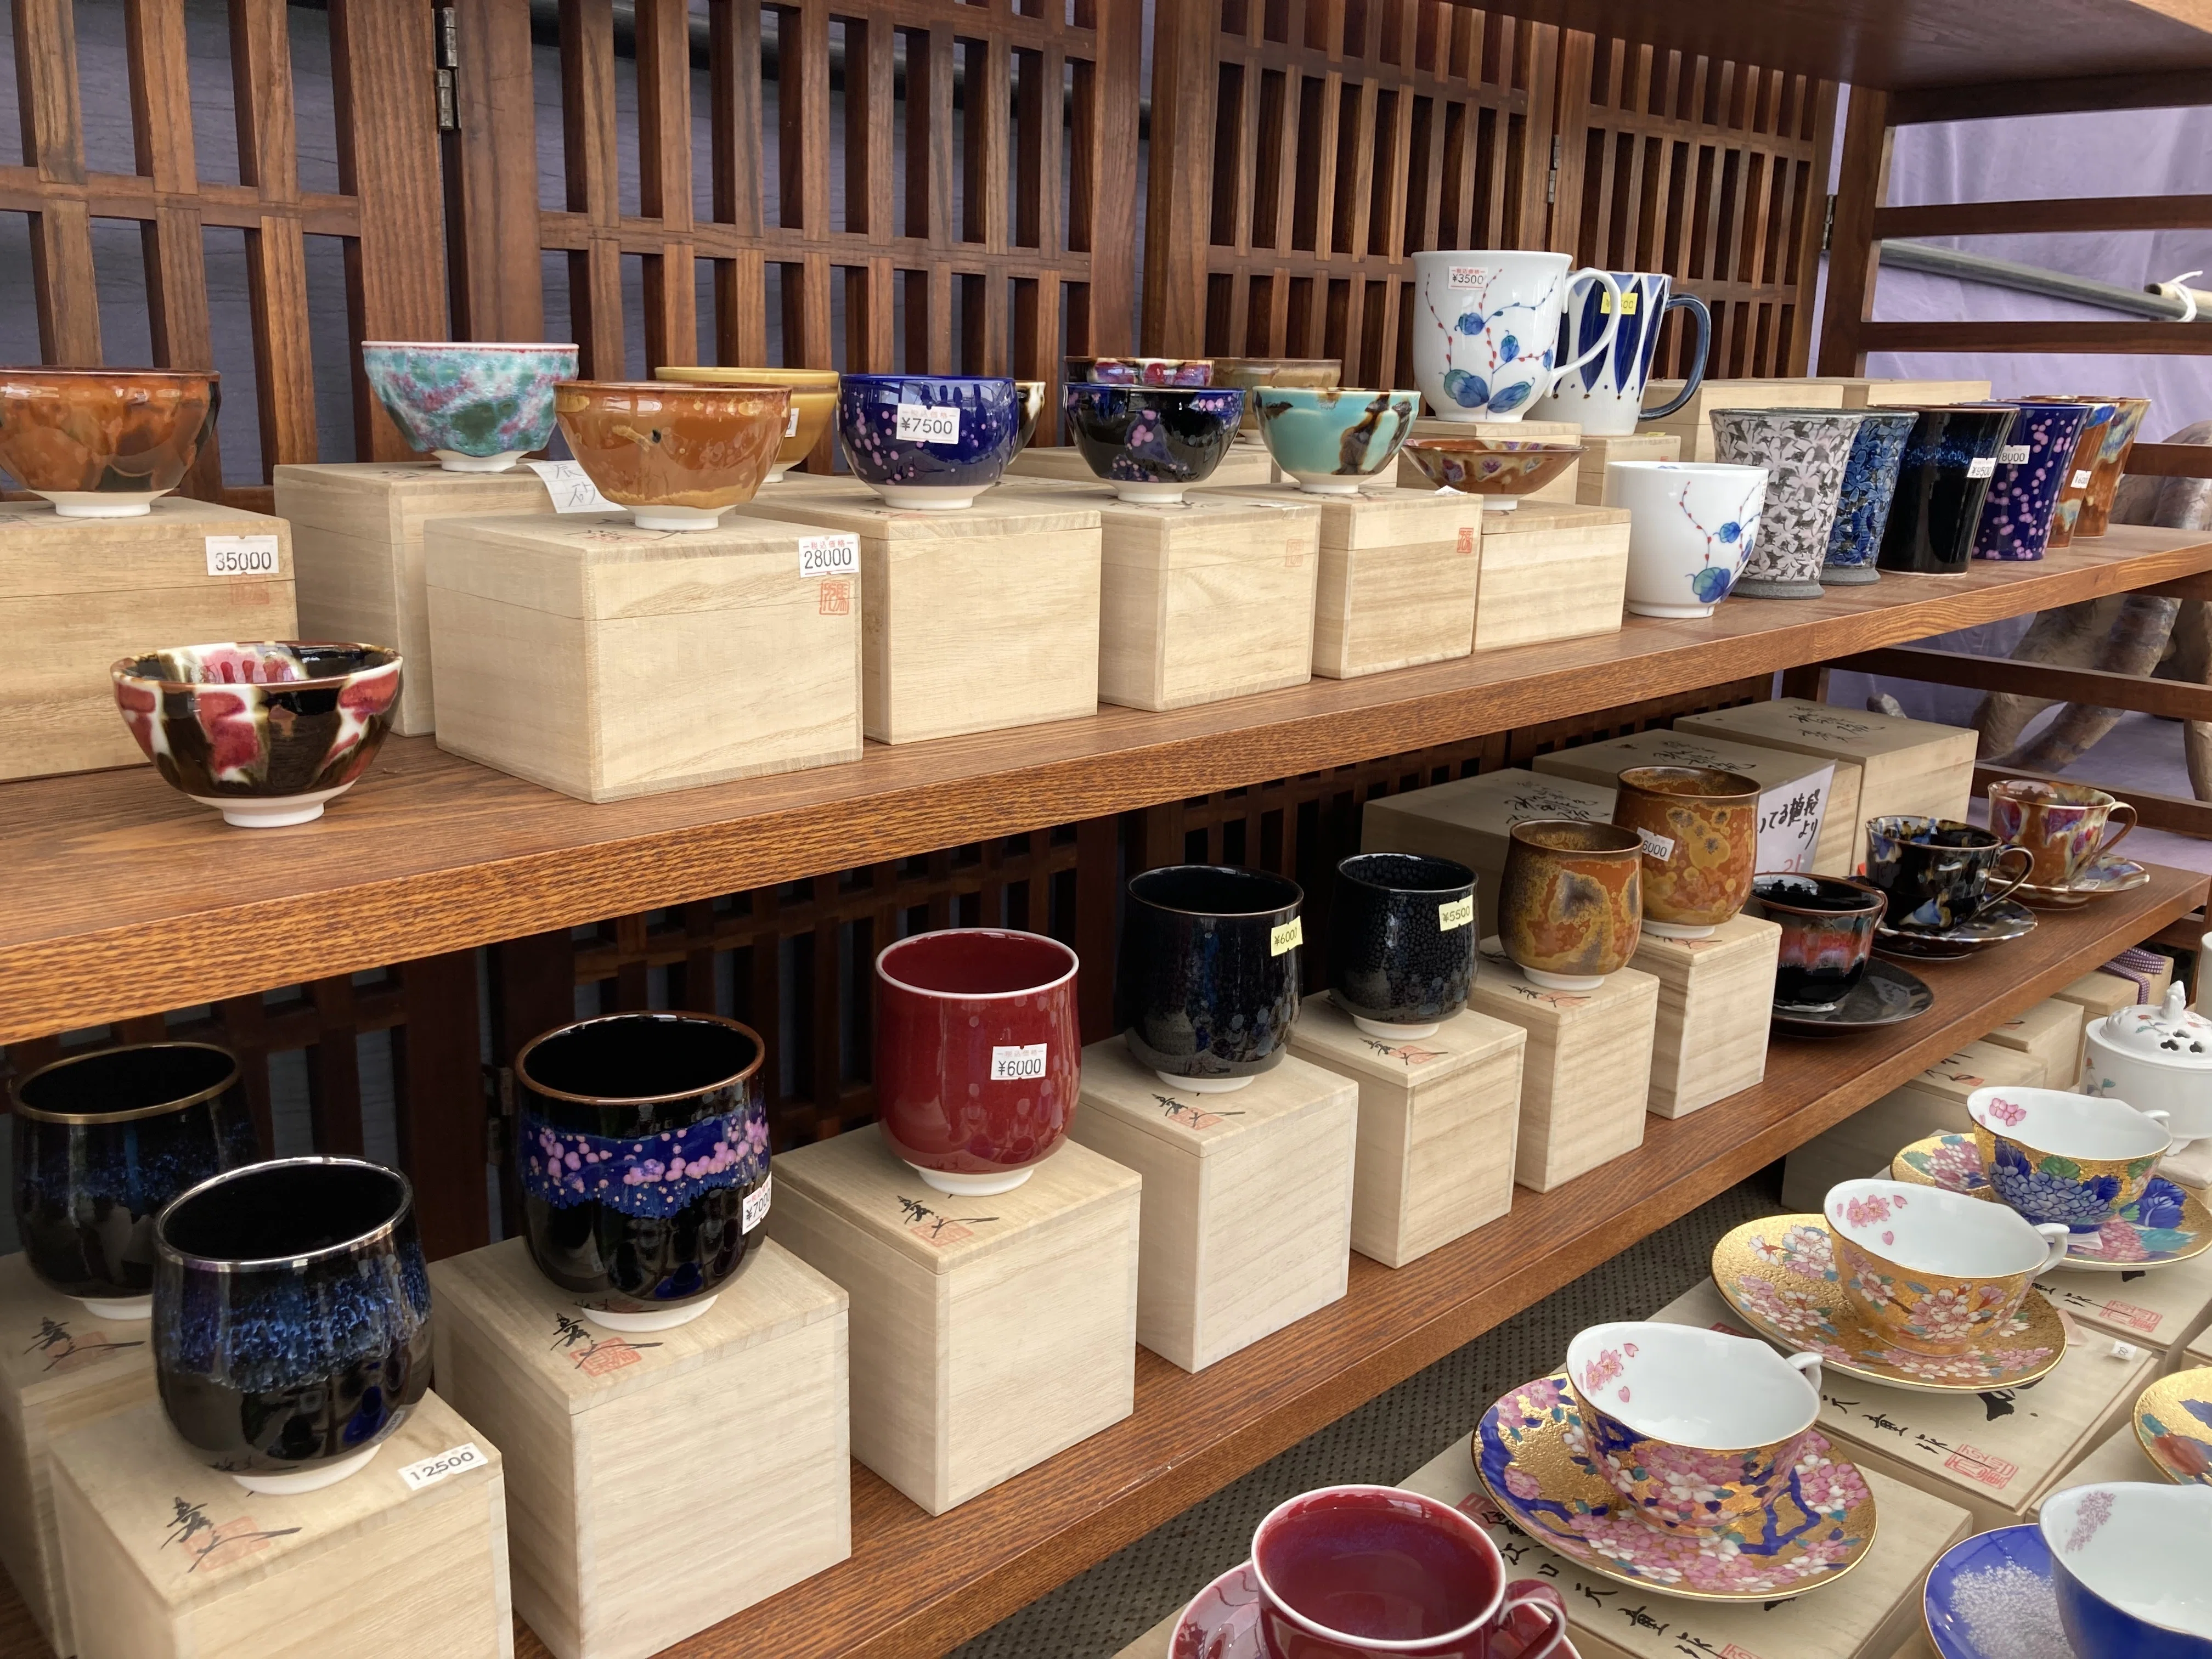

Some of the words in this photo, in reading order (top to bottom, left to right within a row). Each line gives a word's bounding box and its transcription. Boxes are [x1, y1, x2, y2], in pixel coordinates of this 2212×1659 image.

[1452, 273, 1484, 284] ¥3500
[901, 417, 953, 434] ¥7500
[810, 539, 845, 550] 税込価格
[215, 552, 272, 571] 35000
[804, 548, 852, 569] 28000
[1442, 905, 1471, 922] ¥5500
[1274, 927, 1298, 946] ¥6000
[998, 1058, 1041, 1076] ¥6000
[410, 1452, 475, 1480] 12500
